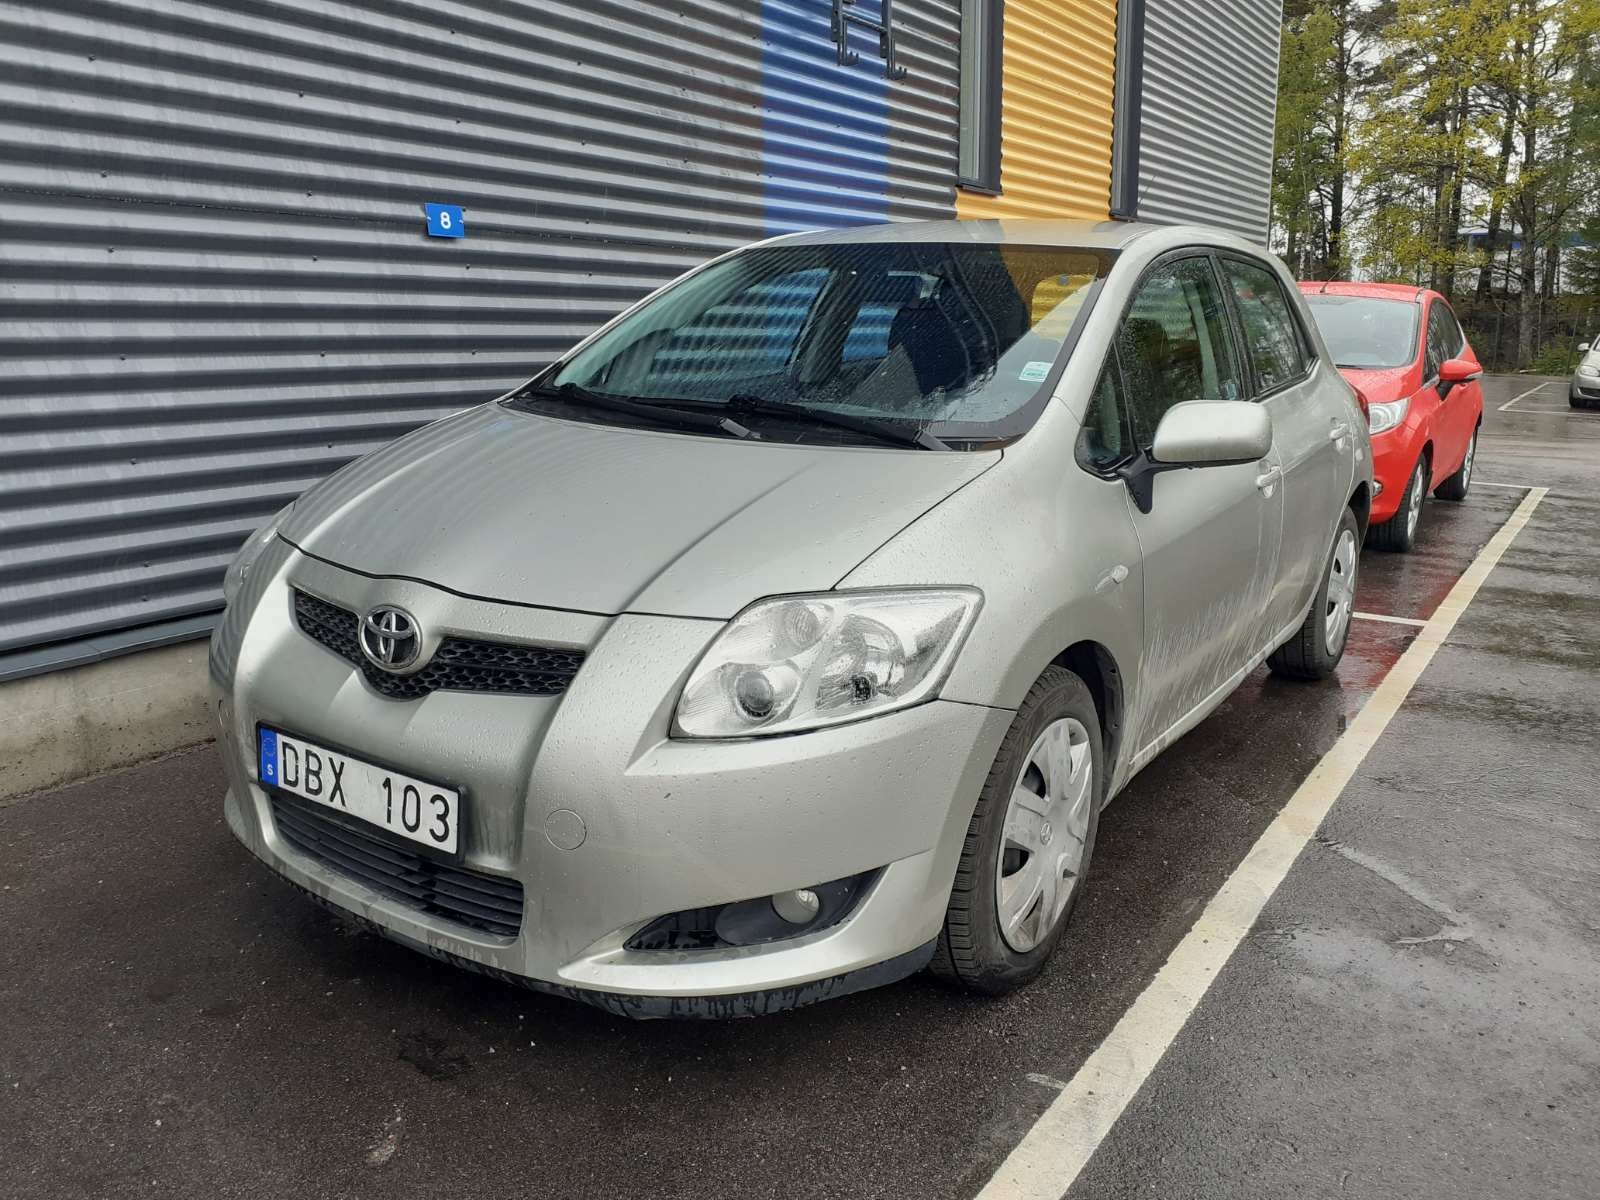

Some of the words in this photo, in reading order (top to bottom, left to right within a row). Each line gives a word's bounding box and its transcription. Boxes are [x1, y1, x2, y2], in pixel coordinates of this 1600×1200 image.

[440, 211, 451, 229] 8
[266, 763, 274, 776] S
[281, 741, 346, 807] DBX
[382, 777, 450, 843] 103
